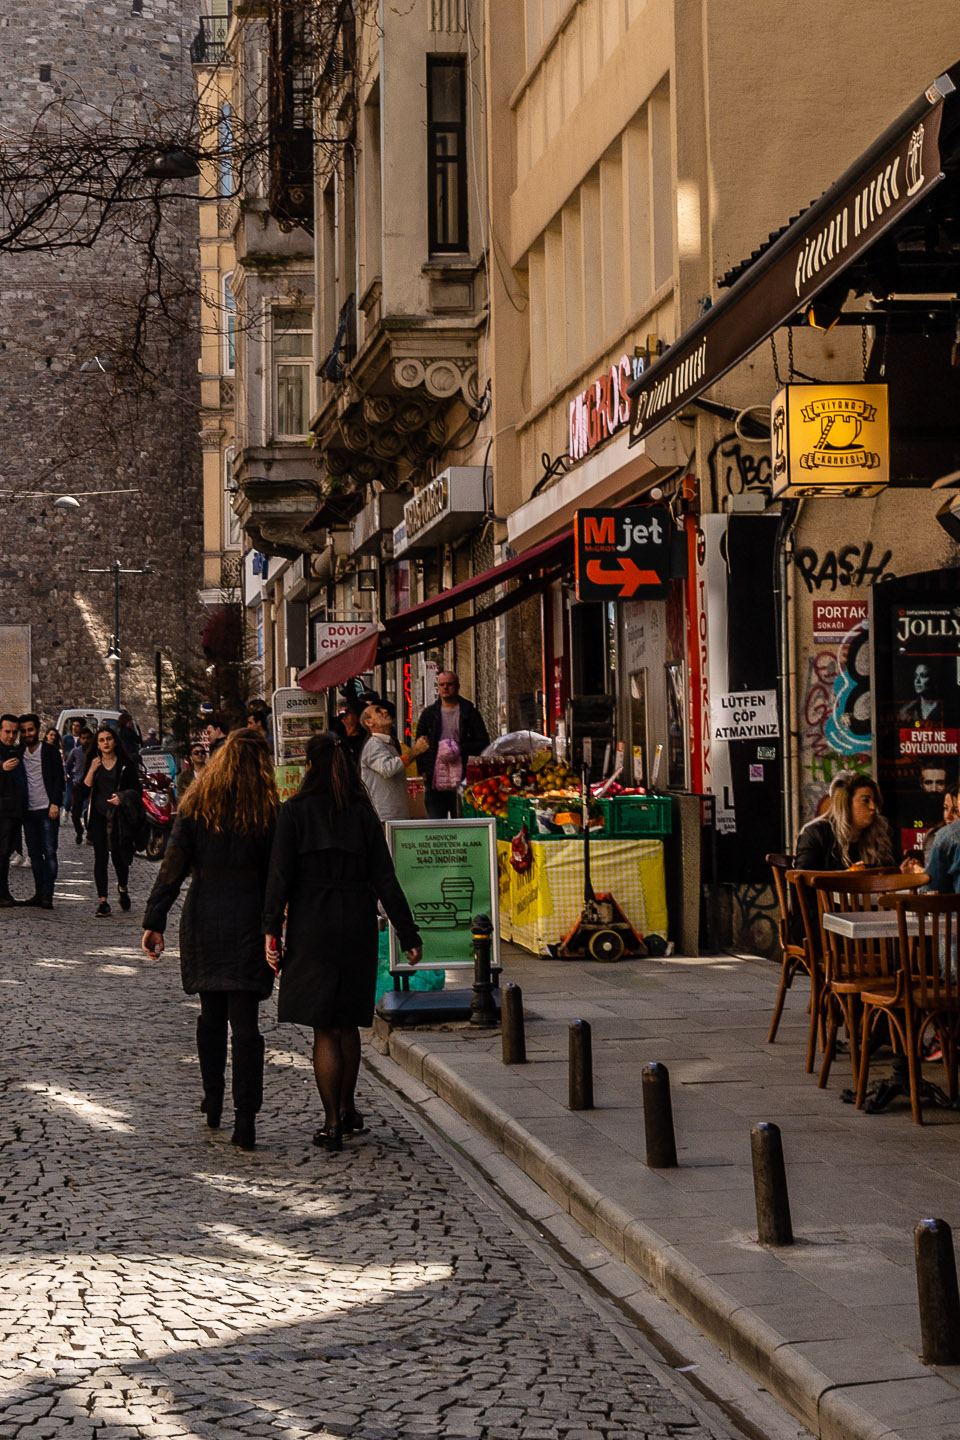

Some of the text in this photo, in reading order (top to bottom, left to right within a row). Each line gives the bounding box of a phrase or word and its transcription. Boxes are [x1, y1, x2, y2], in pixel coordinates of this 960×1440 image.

[819, 400, 857, 410] VİYANA
[819, 454, 860, 465] KAHVESİ
[816, 606, 868, 619] PORTAK
[328, 624, 367, 636] DÖVİZ
[816, 621, 845, 629] SOKAĞI
[286, 698, 318, 709] gazete
[721, 695, 766, 708] LÜTFEN
[733, 709, 756, 725] ÇÖP
[715, 724, 778, 738] ATMAYINIZ
[911, 731, 947, 742] EVET NE
[900, 741, 958, 754] SÖYLÜYODUK
[913, 820, 924, 828] 20
[416, 857, 433, 865] %40
